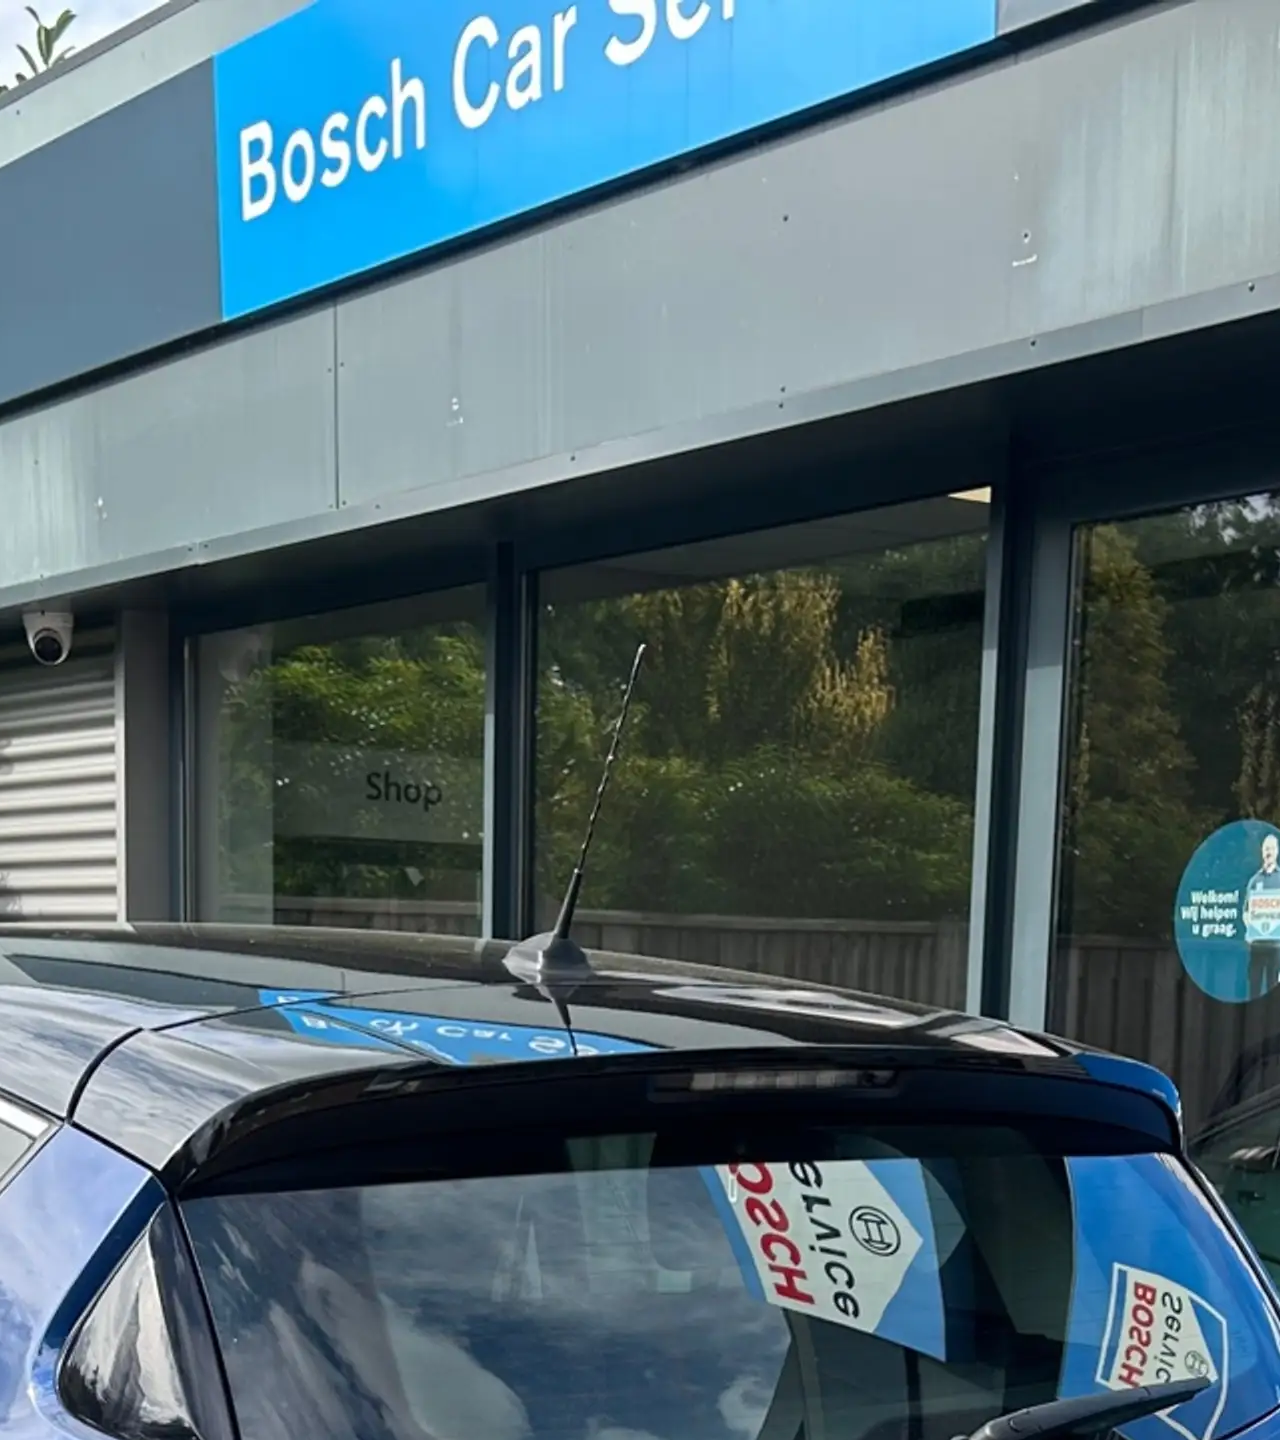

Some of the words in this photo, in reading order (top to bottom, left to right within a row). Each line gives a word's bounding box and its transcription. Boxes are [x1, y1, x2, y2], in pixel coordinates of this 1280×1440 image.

[239, 57, 426, 222] Bosch
[451, 5, 577, 130] Car
[365, 771, 443, 811] Shop
[1190, 889, 1240, 904] Welkom!
[1181, 906, 1198, 921] Wij
[1200, 906, 1237, 921] helpen
[1192, 924, 1200, 934] u
